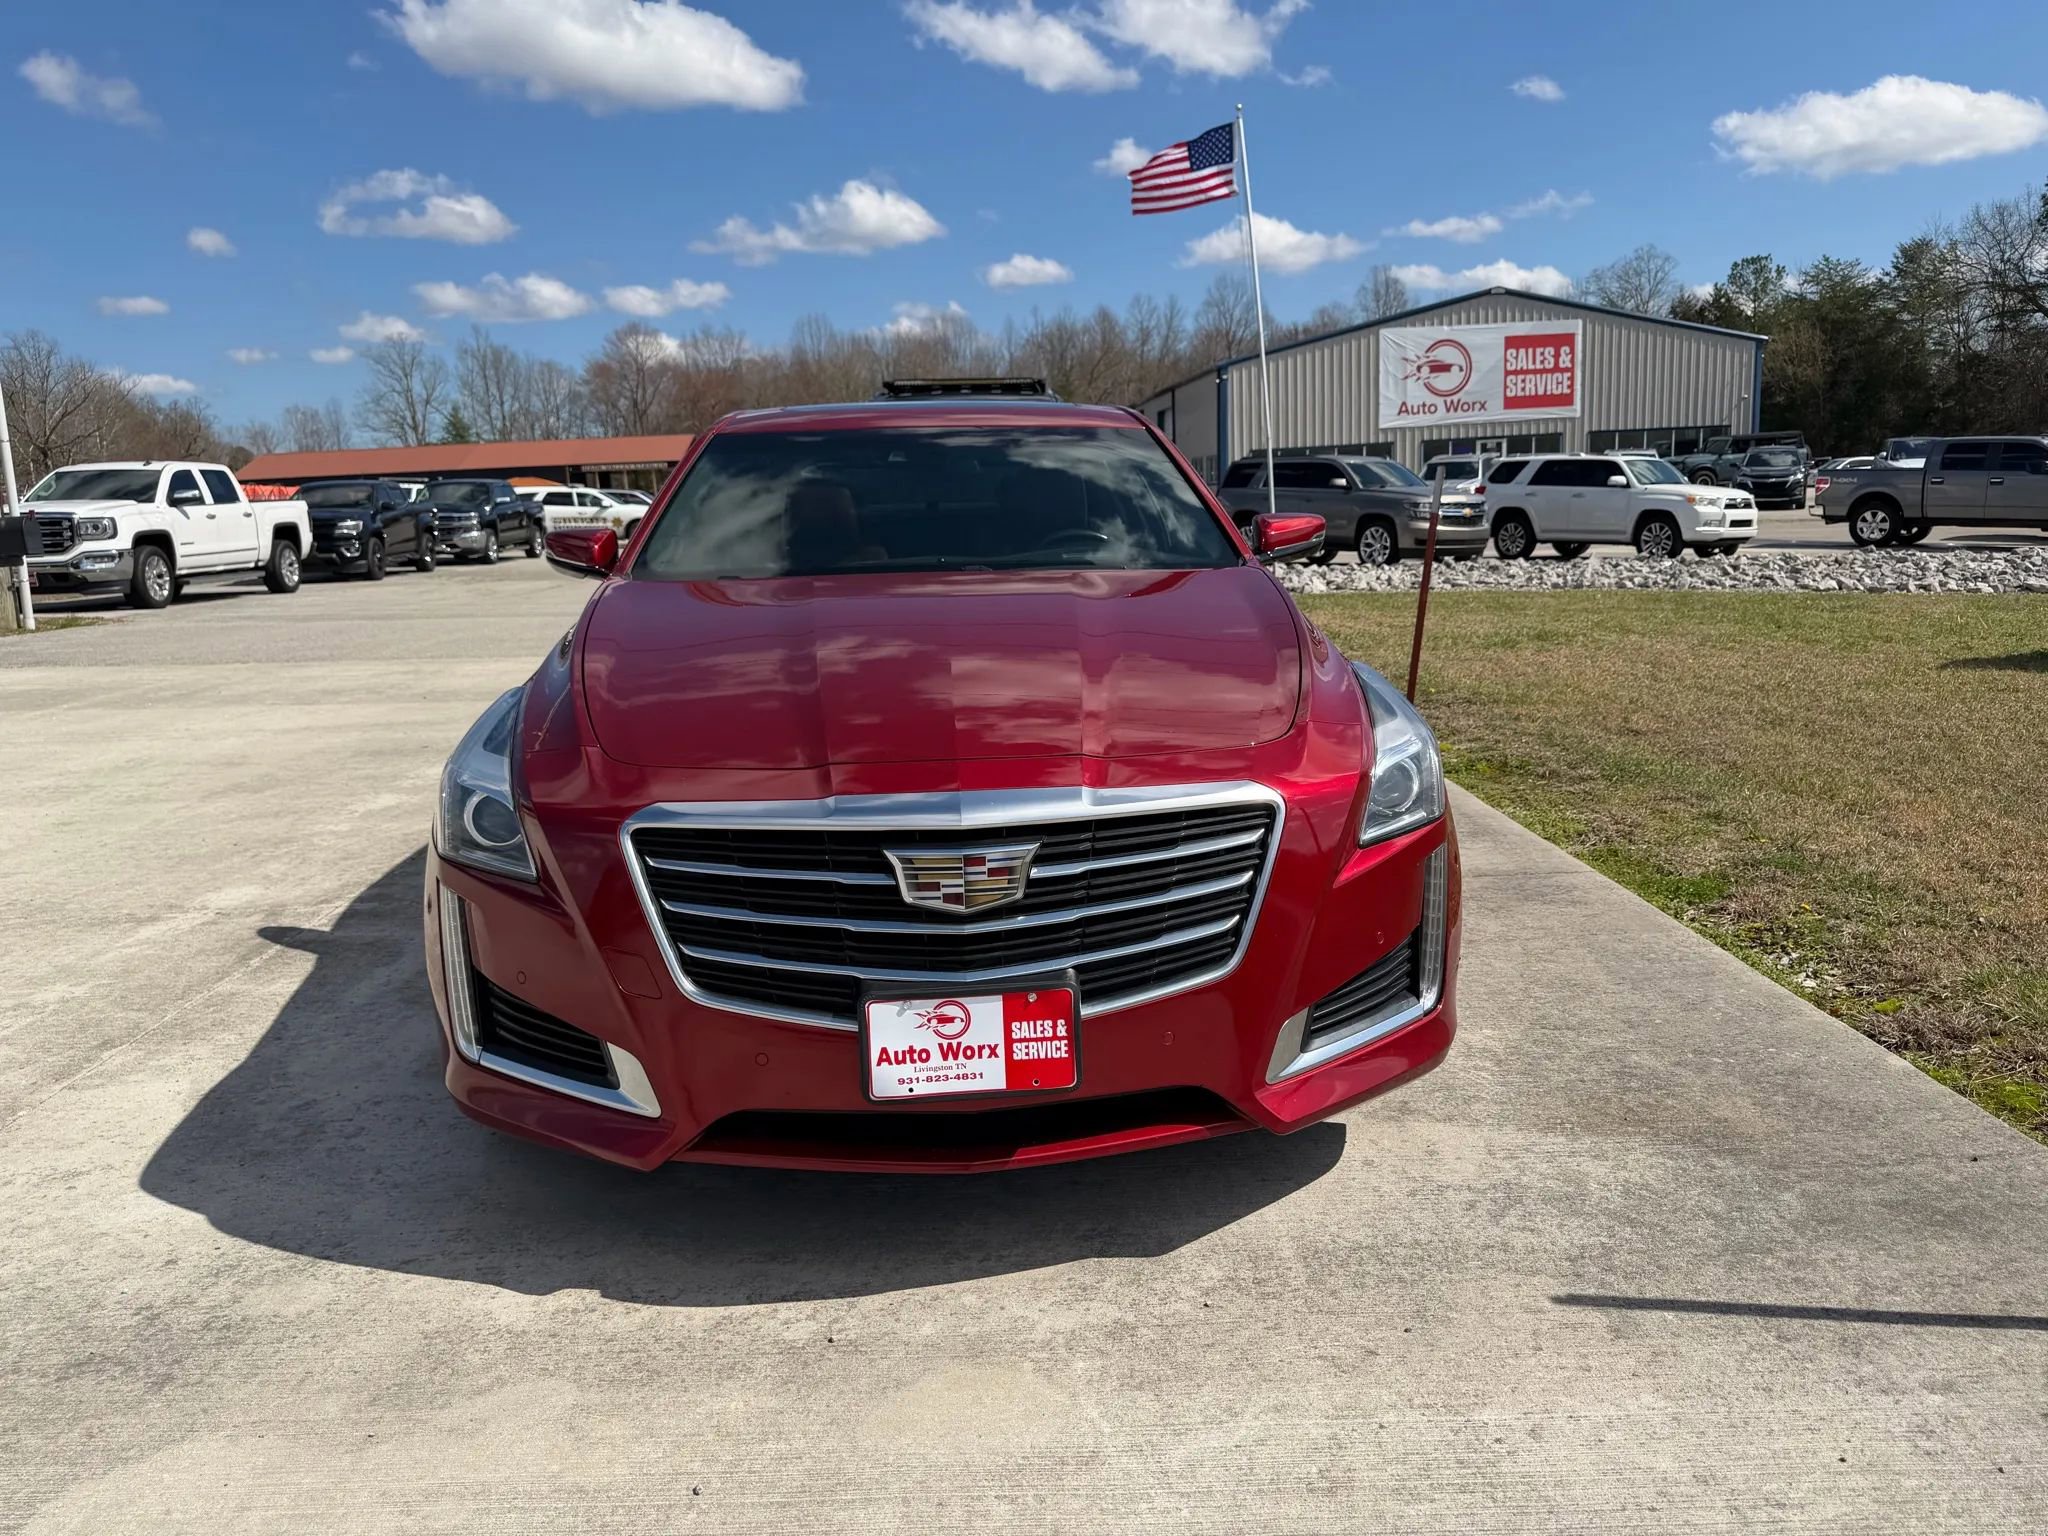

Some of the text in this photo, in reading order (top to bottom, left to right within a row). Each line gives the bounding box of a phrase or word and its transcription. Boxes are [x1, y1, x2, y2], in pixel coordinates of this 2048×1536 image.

[1506, 345, 1572, 371] SALES &
[1506, 372, 1571, 397] SERVICE
[1397, 399, 1488, 417] Auto Worx
[1011, 1019, 1068, 1039] SALES &
[876, 1041, 1000, 1067] Auto Worx
[1012, 1040, 1069, 1060] SERVICE
[914, 1062, 967, 1073] Livingston TN
[897, 1072, 984, 1085] 931-823-4831
